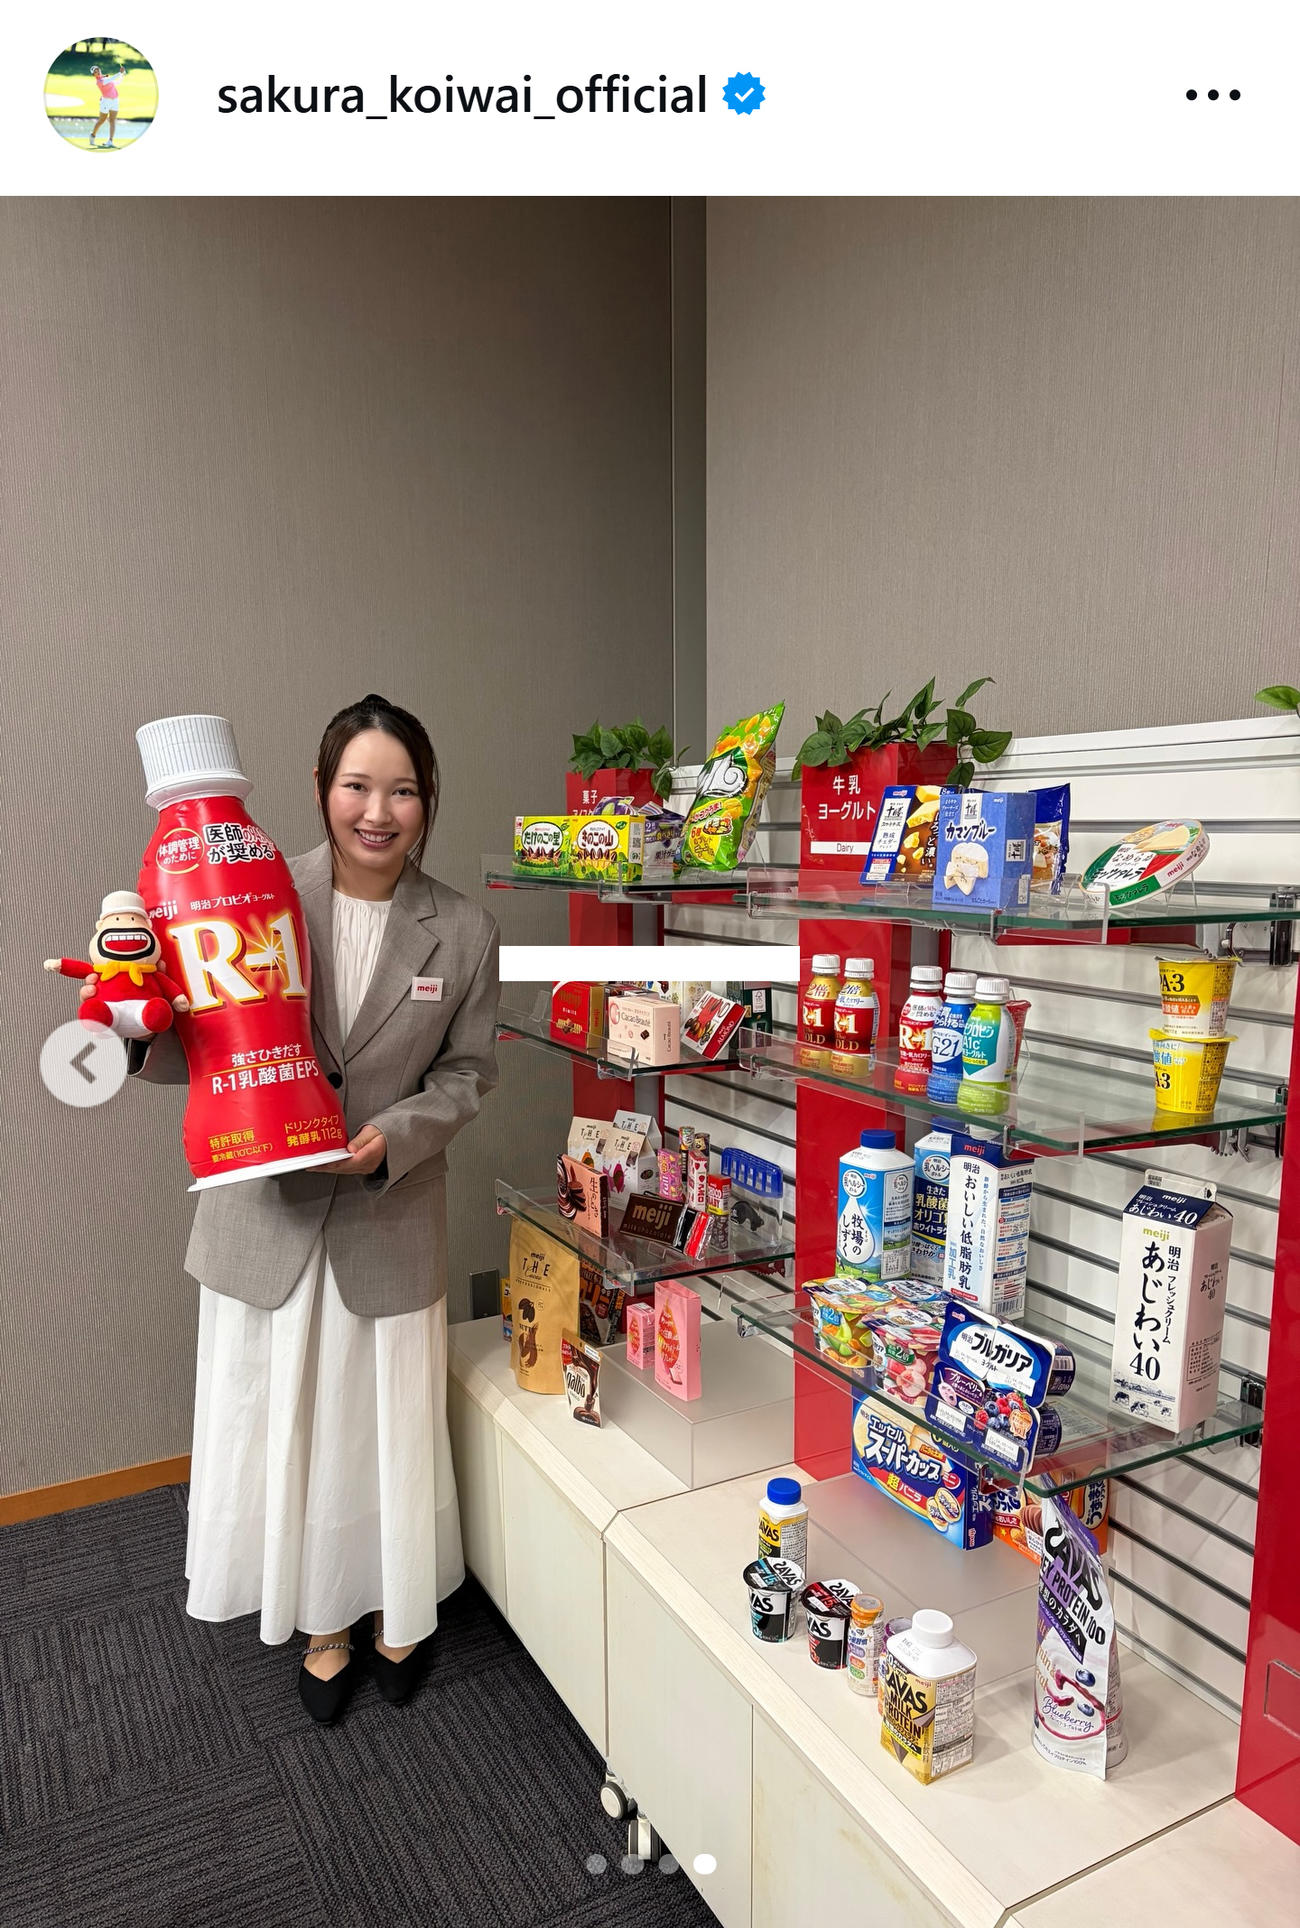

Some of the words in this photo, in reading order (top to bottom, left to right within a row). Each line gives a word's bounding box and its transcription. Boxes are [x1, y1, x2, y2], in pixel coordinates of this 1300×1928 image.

[582, 789, 598, 804] 菓子
[832, 775, 861, 796] 牛乳
[818, 801, 877, 822] ヨーグルト
[523, 831, 561, 846] たけのこの里
[581, 829, 614, 847] きのこの山
[945, 819, 996, 842] カマンブルー
[158, 835, 202, 856] 体調管理
[163, 850, 198, 865] のために
[207, 843, 276, 864] が奨める
[835, 841, 855, 855] Dairy
[1166, 860, 1186, 879] meiji
[169, 910, 308, 1015] R-1
[416, 982, 438, 993] meiji
[717, 1020, 735, 1045] ALMOND
[899, 1024, 932, 1051] R-1
[231, 1042, 302, 1067] 強さひきだす
[211, 1059, 320, 1095] R-1乳酸菌EPS
[284, 1114, 340, 1134] ドリンクタイプ
[209, 1129, 256, 1150] 特許取得
[963, 1142, 986, 1155] meiji
[963, 1161, 981, 1175] 明治
[926, 1185, 946, 1197] 生きた
[1138, 1194, 1153, 1202] 明治
[1161, 1193, 1187, 1204] meiji
[631, 1203, 672, 1230] meiji
[841, 1214, 851, 1257] しずく
[851, 1213, 864, 1256] 牧場の
[957, 1175, 978, 1291] おいしい低脂肪乳
[1142, 1227, 1170, 1241] meiji
[522, 1257, 551, 1278] THE
[947, 1245, 957, 1280] 加工乳
[1166, 1245, 1181, 1272] 明治
[1132, 1241, 1166, 1353] あじわい
[1162, 1275, 1179, 1345] フレッシュクリーム
[971, 1331, 1033, 1373] ブルガリア
[1129, 1352, 1161, 1381] 40
[566, 1371, 586, 1399] galbo
[868, 1415, 905, 1443] エッセル
[865, 1431, 942, 1481] スーパーカップ
[887, 1473, 899, 1491] 超
[900, 1482, 923, 1502] バニラ
[942, 1472, 957, 1487] ミニ
[772, 1560, 802, 1587] SAVAS
[1051, 1572, 1089, 1627] PROTEIN
[1086, 1614, 1107, 1646] 100
[914, 1678, 932, 1688] meiji
[889, 1691, 913, 1719] MILK
[1041, 1695, 1094, 1733] Blueberry
